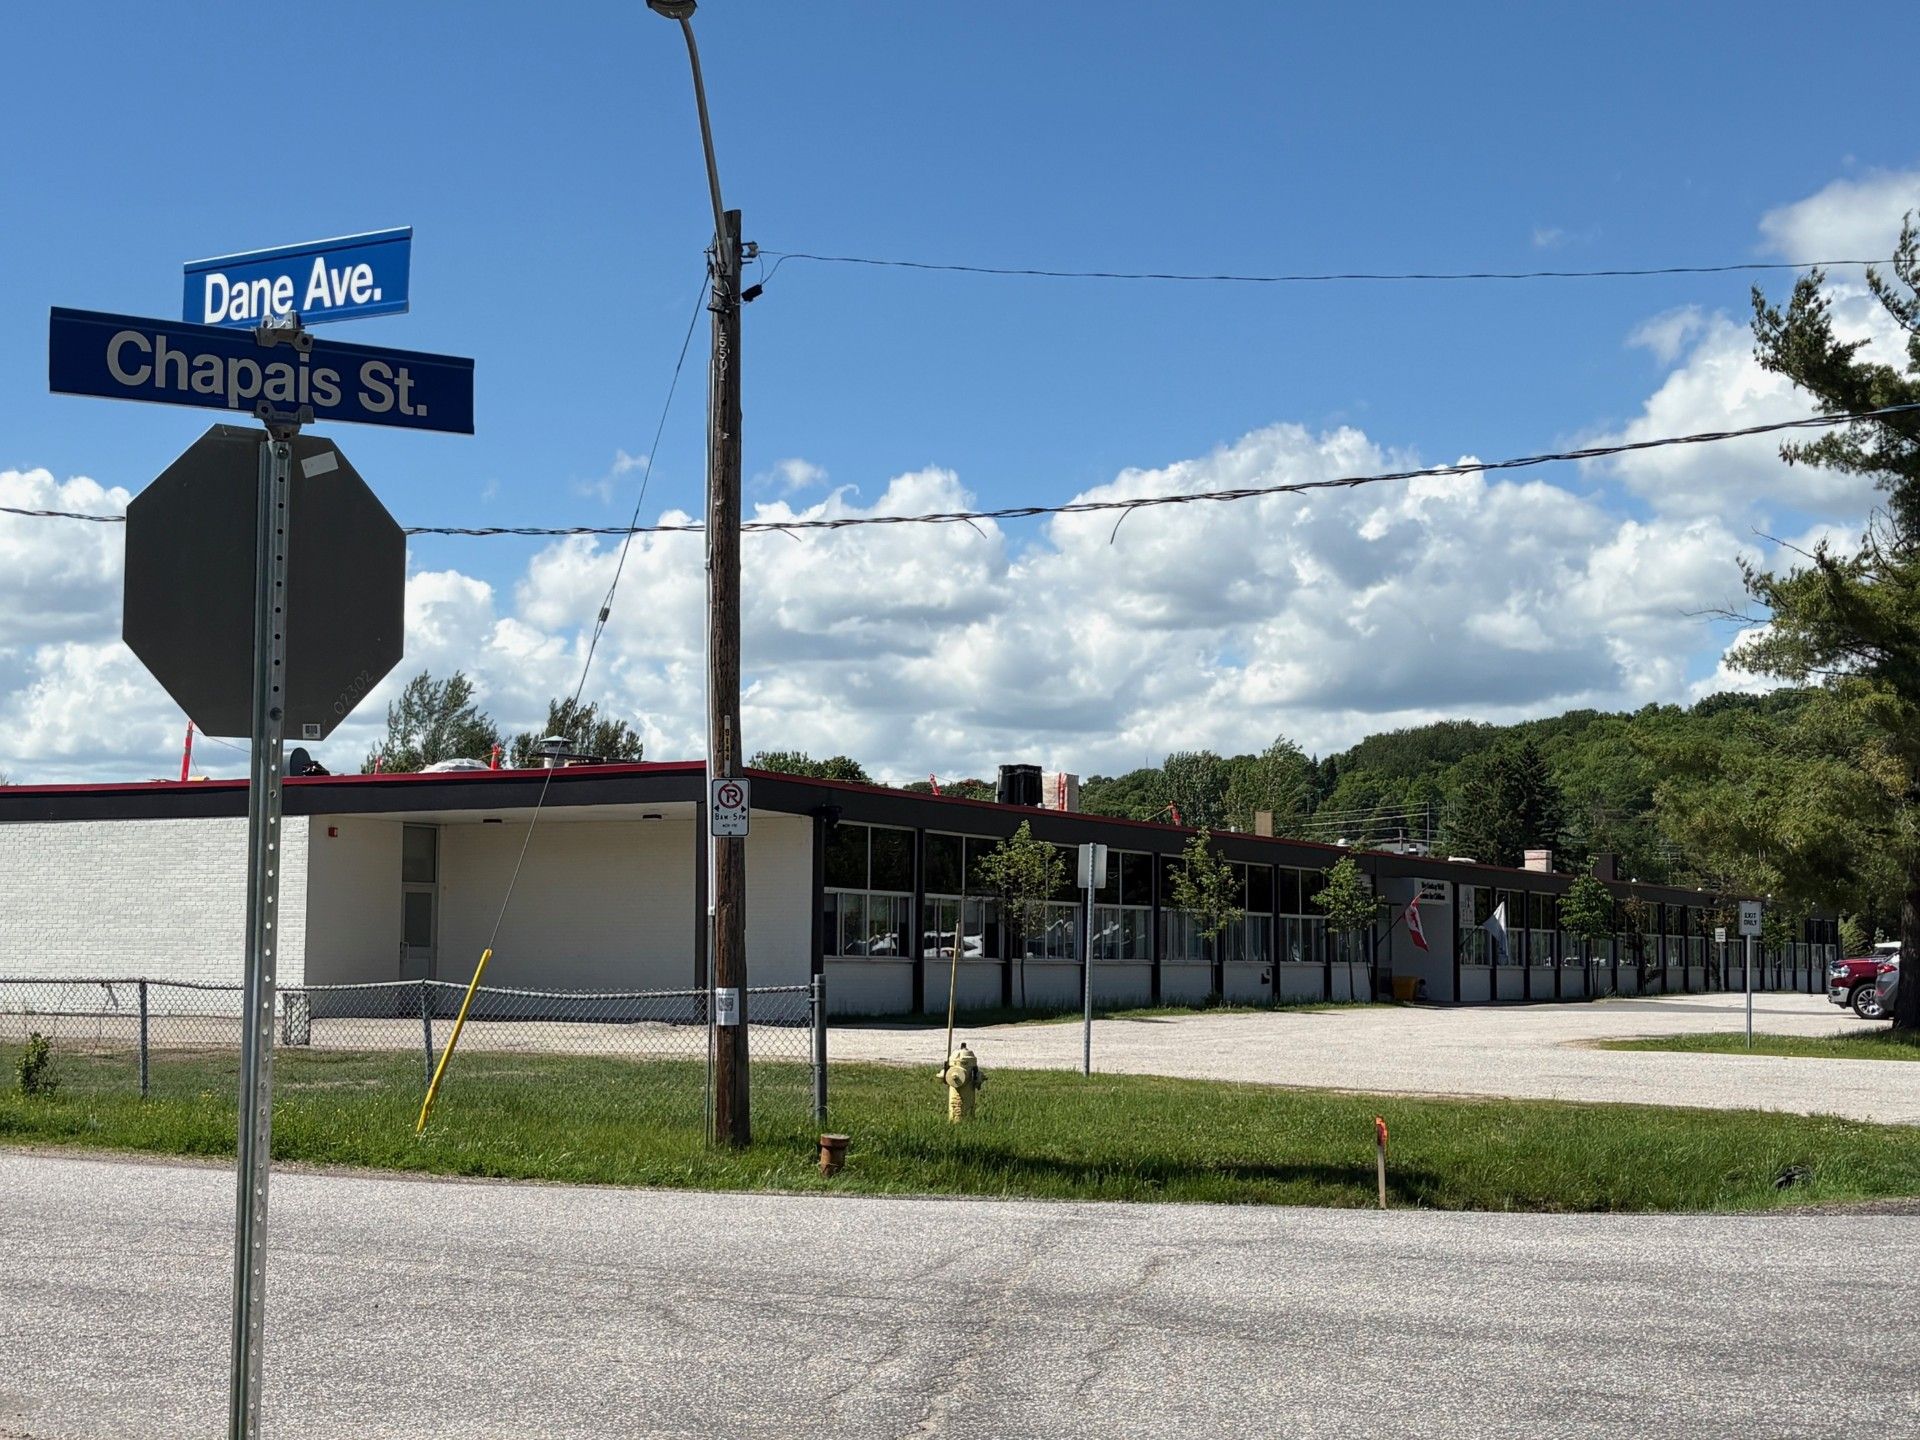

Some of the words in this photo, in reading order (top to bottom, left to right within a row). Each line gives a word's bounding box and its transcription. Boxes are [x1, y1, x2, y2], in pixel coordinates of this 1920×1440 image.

[204, 272, 294, 324] Dane
[303, 257, 382, 310] Ave.
[106, 331, 341, 408] Chapais
[359, 361, 428, 416] St.
